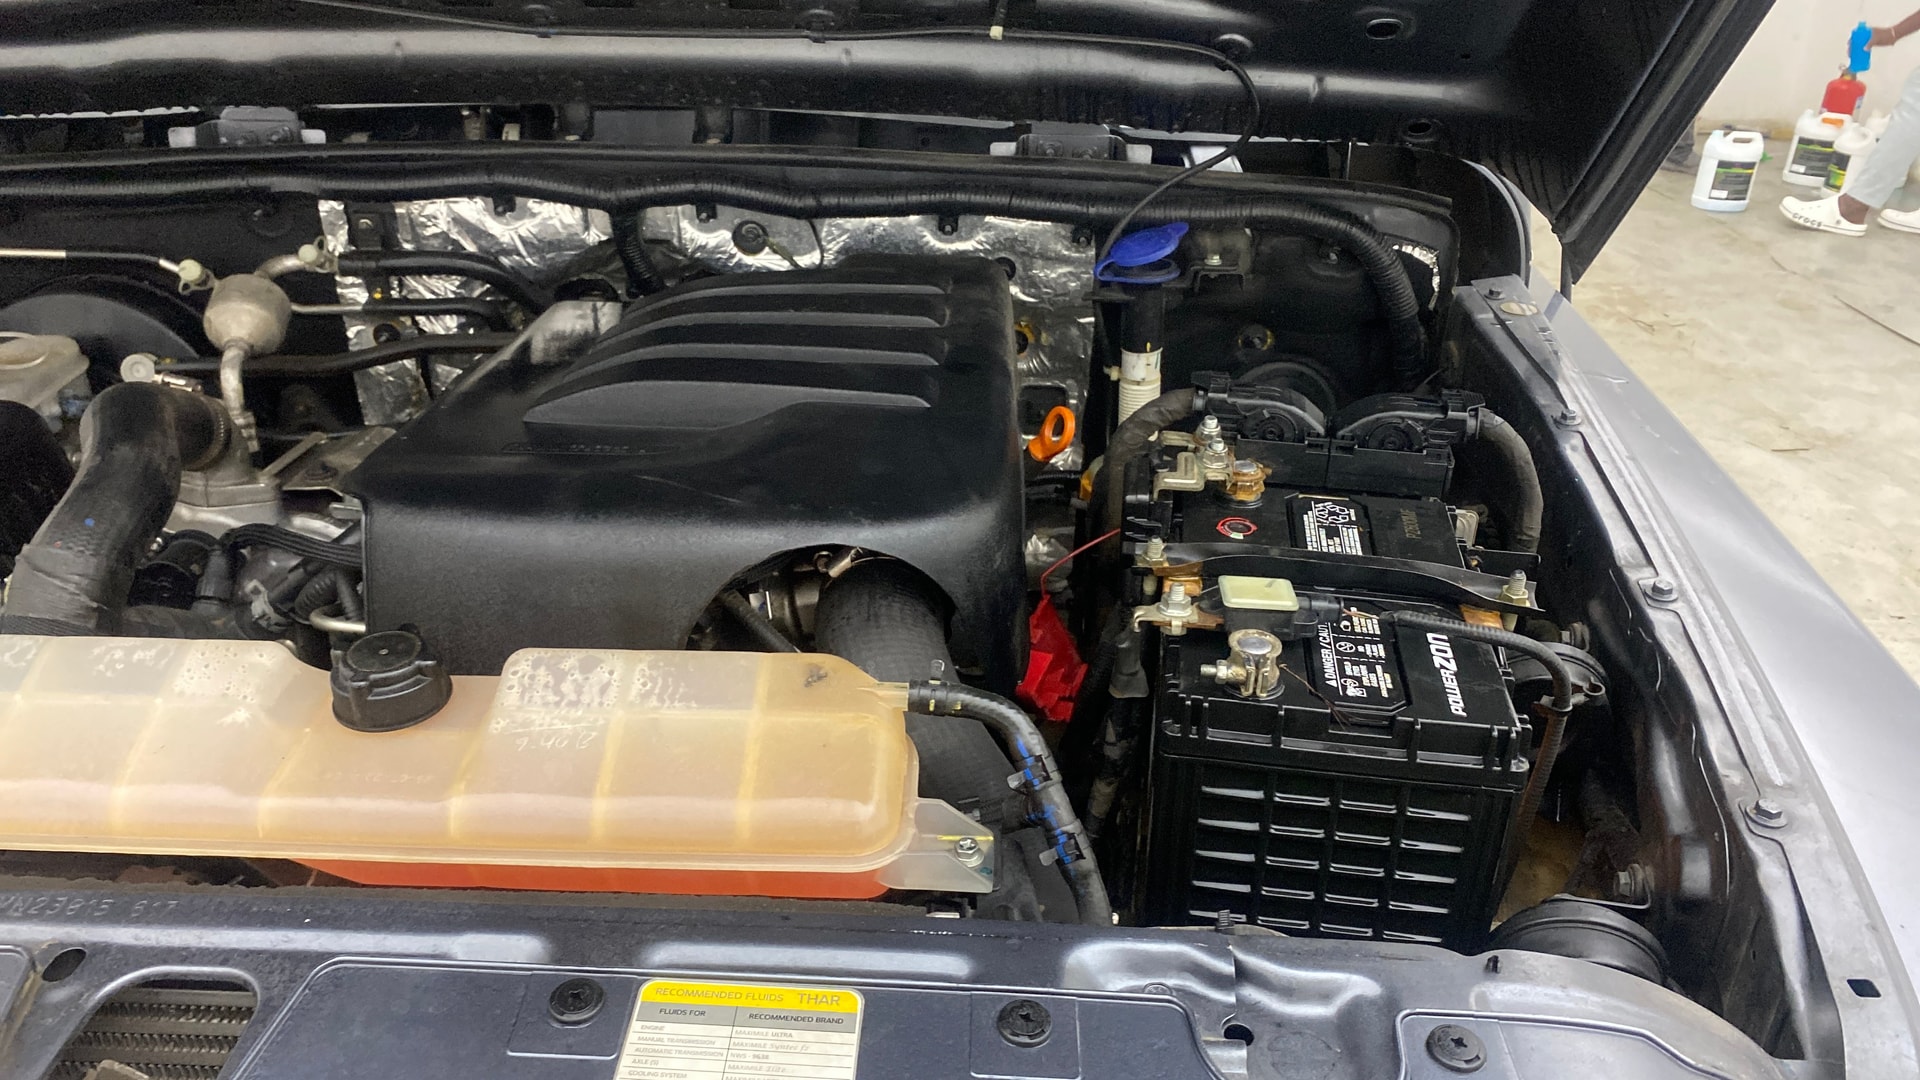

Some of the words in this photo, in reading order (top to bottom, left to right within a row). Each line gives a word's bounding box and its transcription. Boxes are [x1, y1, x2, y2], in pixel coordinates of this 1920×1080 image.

[1792, 212, 1822, 227] crocs
[1426, 632, 1467, 717] POWERZON
[655, 987, 743, 1000] RECOMMENDED
[745, 992, 784, 1002] FLUIDS
[797, 992, 841, 1006] THAR
[748, 1012, 814, 1023] RECOMMENDED
[815, 1017, 844, 1025] BRAND
[634, 1047, 674, 1055] AUTOMATIC
[628, 1069, 659, 1077] COOLING
[659, 1071, 688, 1079] SYSTEM
